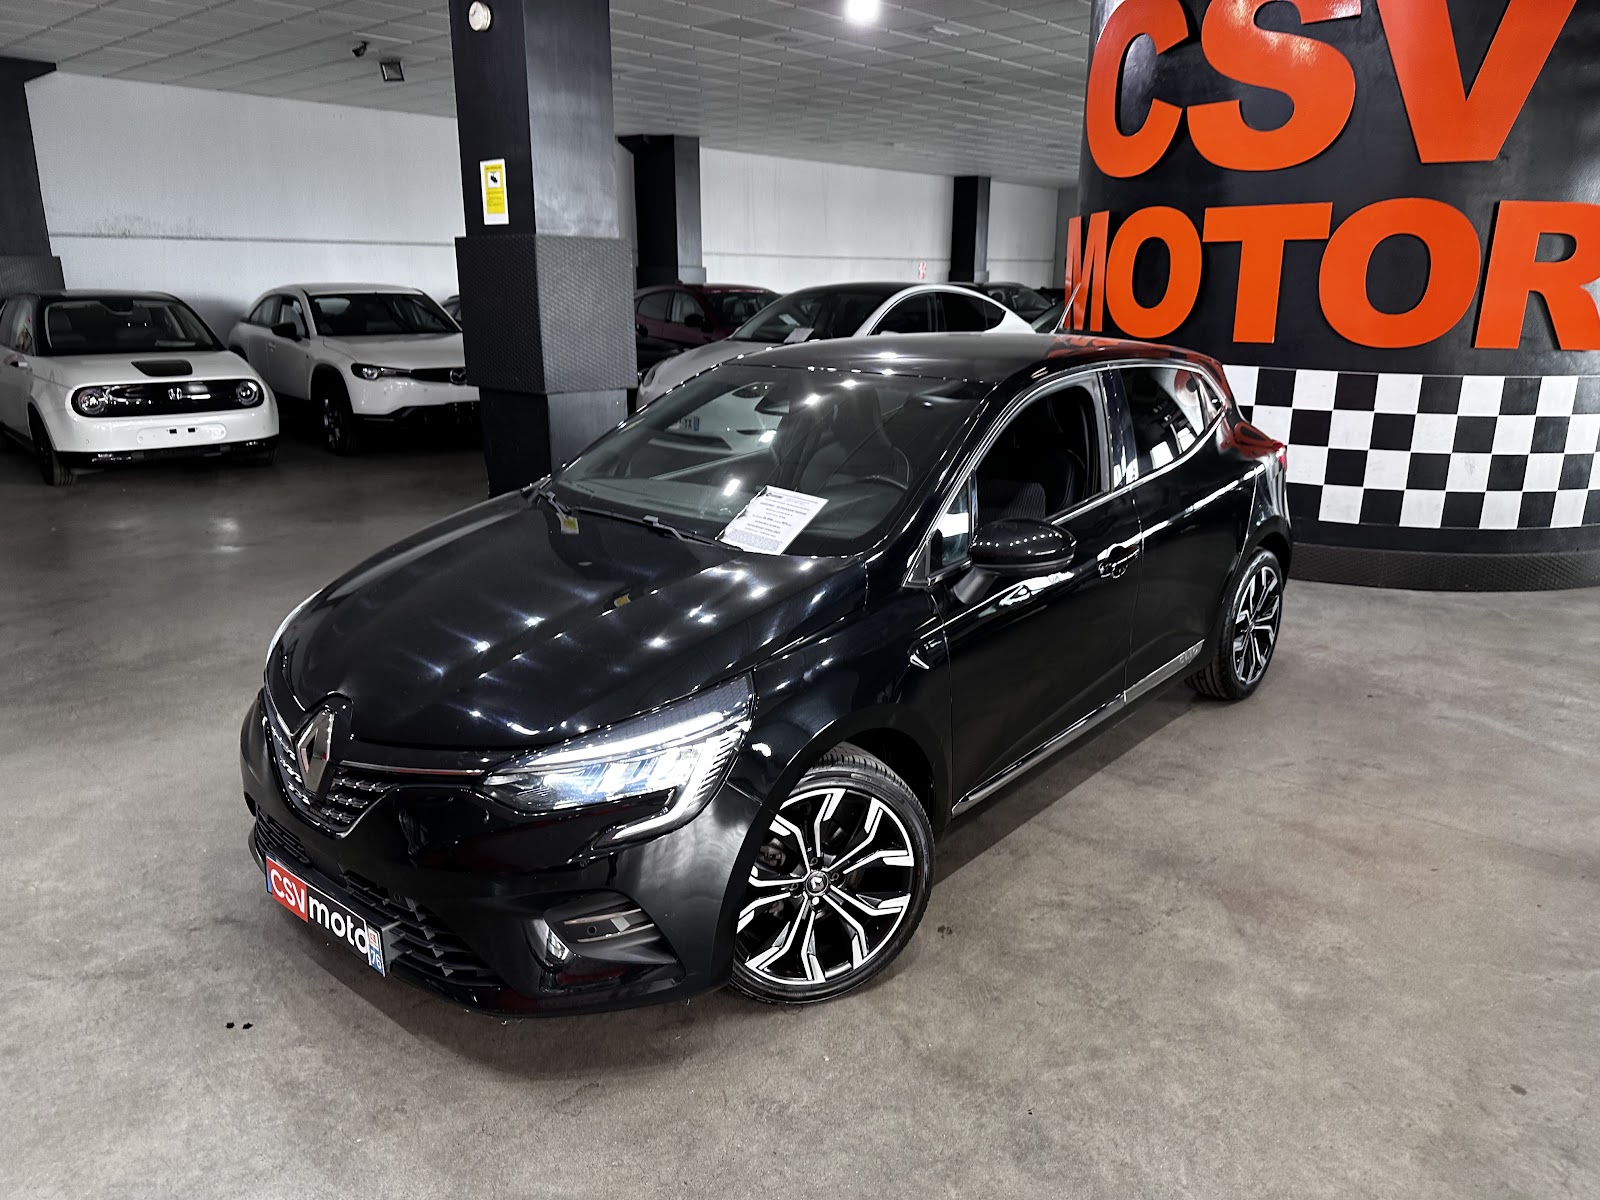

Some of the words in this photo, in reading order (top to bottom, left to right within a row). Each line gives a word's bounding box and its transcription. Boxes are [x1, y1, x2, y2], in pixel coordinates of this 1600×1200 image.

[1086, 0, 1577, 178] CSV
[1064, 197, 1600, 351] MOTOR
[370, 949, 382, 970] 76
